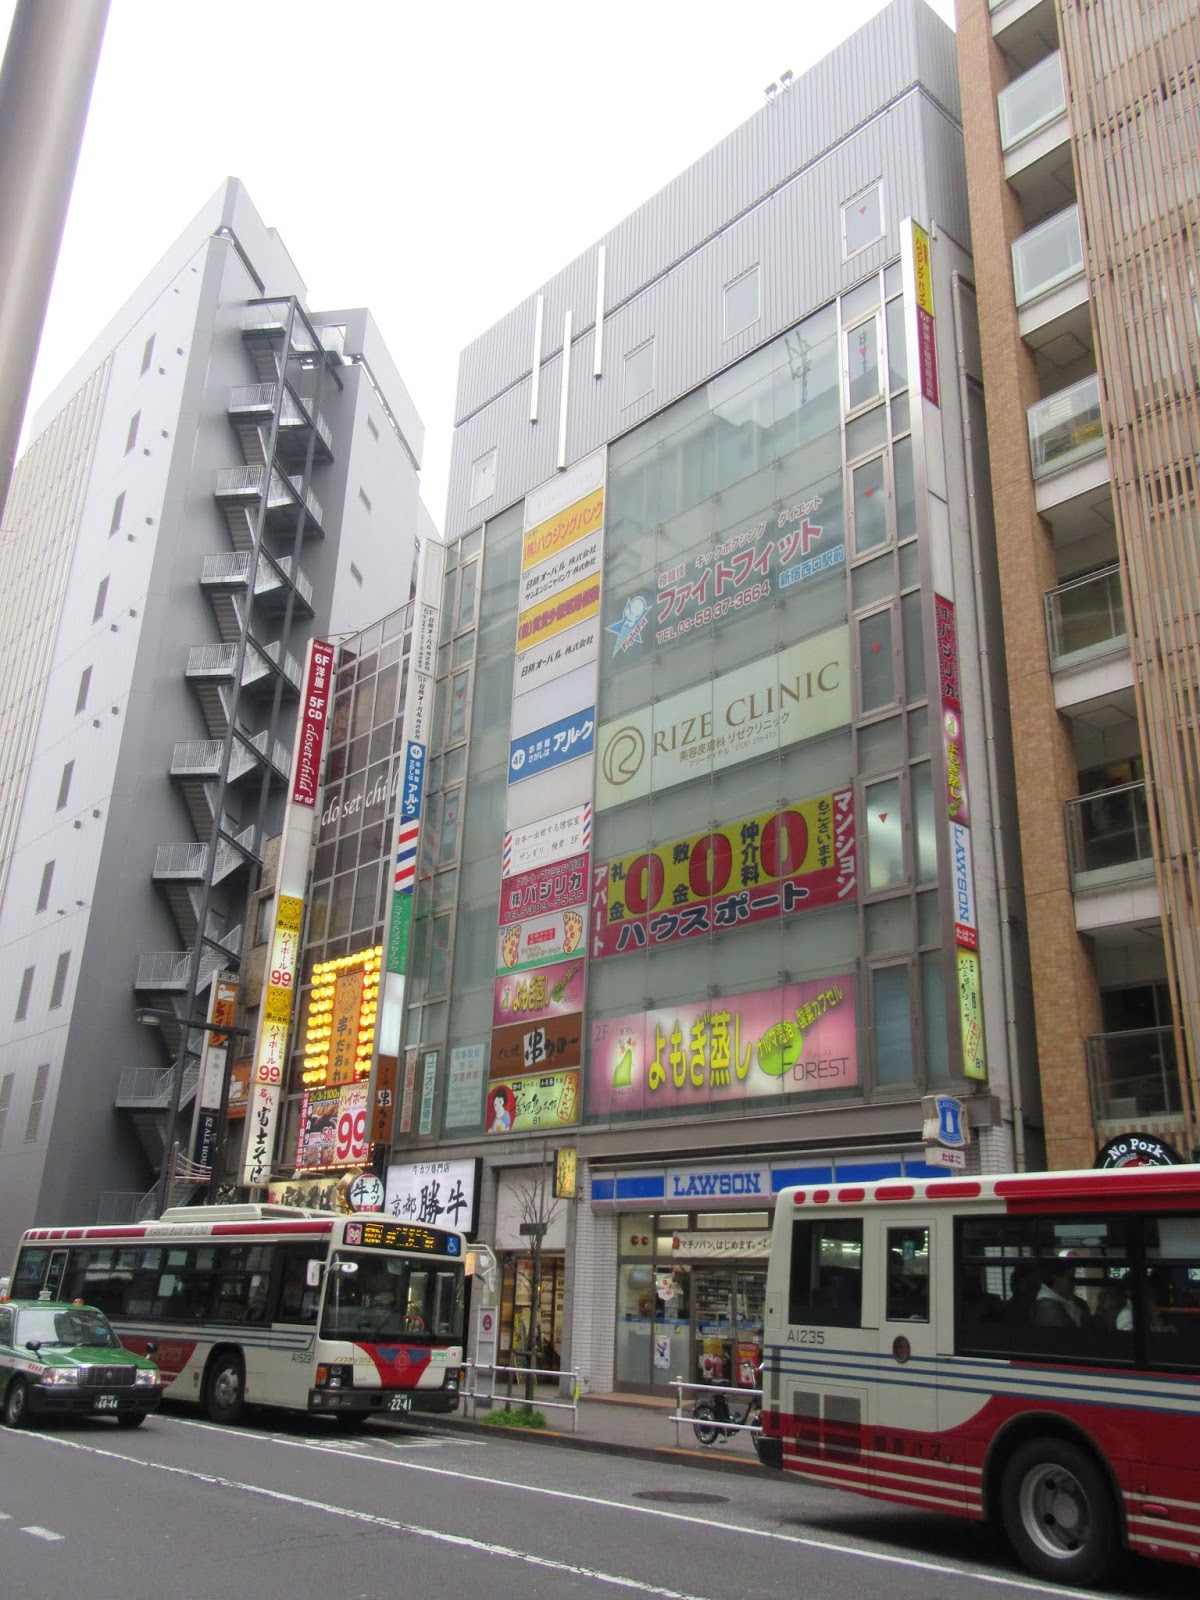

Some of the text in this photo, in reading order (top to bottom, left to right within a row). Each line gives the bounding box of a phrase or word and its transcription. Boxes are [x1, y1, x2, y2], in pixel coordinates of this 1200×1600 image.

[658, 495, 823, 588] 格闘技 キックボクシング ダイエット
[656, 518, 823, 624] ファイトフィット
[778, 544, 845, 590] 新宿西口駅前
[656, 580, 770, 645] TEL 03-5937-3664
[314, 653, 330, 666] 6F
[314, 666, 326, 690] 洋服
[417, 674, 428, 684] 5F
[308, 708, 323, 720] CD
[309, 696, 324, 710] 5F
[652, 661, 840, 757] RIZE CLINIC
[528, 737, 551, 754] お部屋
[553, 720, 594, 753] アルク
[679, 712, 790, 763] 美容皮膚科 リゼクリニック
[300, 723, 319, 795] closet child
[512, 754, 524, 766] 4F
[294, 794, 314, 804] 5F 6F
[322, 768, 400, 826] closet chil
[405, 783, 418, 814] アルク
[570, 834, 579, 845] 3F
[760, 810, 808, 879] 0
[816, 800, 831, 868] もございます
[833, 791, 856, 899] マンション
[688, 833, 732, 897] 0
[740, 820, 760, 887] 仲介料
[624, 853, 665, 915] 0
[671, 843, 690, 906] 敷金
[954, 827, 969, 923] LAWSON
[521, 892, 584, 917] 5389-5555
[609, 861, 626, 922] 礼金
[591, 865, 608, 957] アパート
[615, 881, 810, 951] ハウスポート
[956, 929, 976, 945] たばこ
[271, 969, 292, 986] 99
[595, 1024, 609, 1043] 2F
[648, 1010, 752, 1091] よもぎ蒸し
[975, 1058, 984, 1069] B1
[259, 1065, 280, 1082] 99
[260, 1088, 274, 1106] 名代
[206, 1116, 214, 1127] 82
[532, 1116, 542, 1126] B1
[250, 1106, 271, 1183] 富士そば
[336, 1110, 367, 1160] 99
[940, 1152, 962, 1166] たばこ
[1108, 1144, 1128, 1161] No
[1130, 1138, 1164, 1157] Pork
[413, 1162, 450, 1176] 牛カツ専門店
[352, 1178, 380, 1205] 牛カツ
[674, 1172, 761, 1197] LAWSON
[787, 1330, 826, 1346] A1235
[390, 1398, 412, 1410] 22-41
